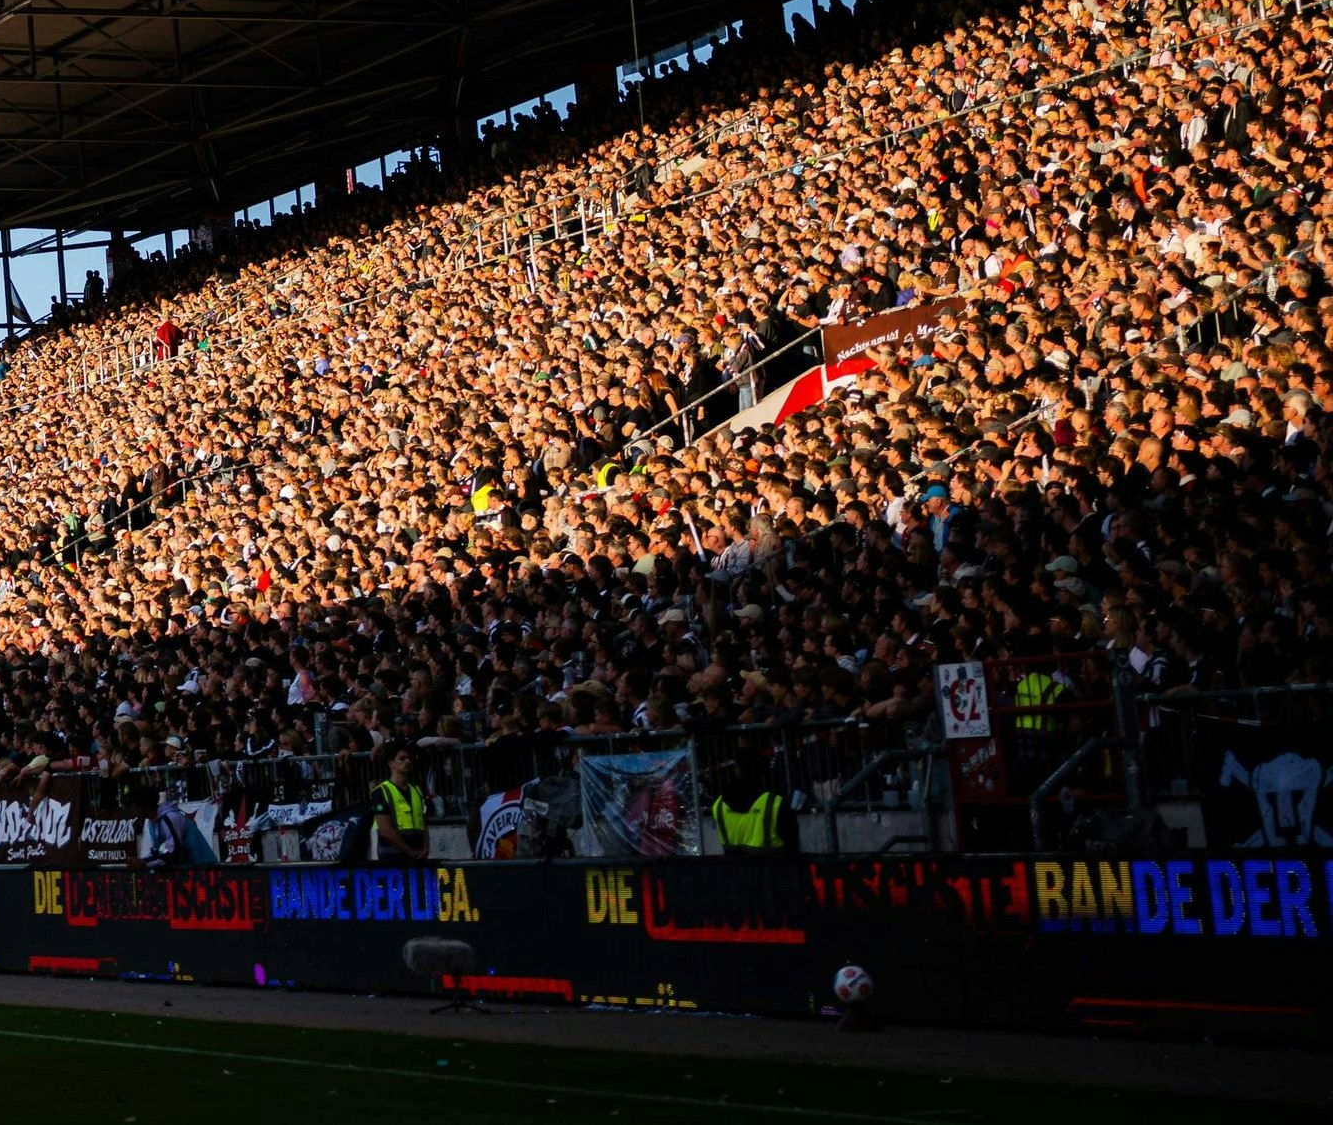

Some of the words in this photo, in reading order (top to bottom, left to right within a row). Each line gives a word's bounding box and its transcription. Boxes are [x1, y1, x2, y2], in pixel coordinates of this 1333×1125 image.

[33, 870, 64, 915] DIE
[269, 866, 351, 921] BANDE
[354, 866, 406, 922] DER
[408, 867, 481, 923] LIGA.
[584, 867, 638, 924] DIE
[1033, 860, 1204, 936] BANDE
[1207, 860, 1318, 938] DER
